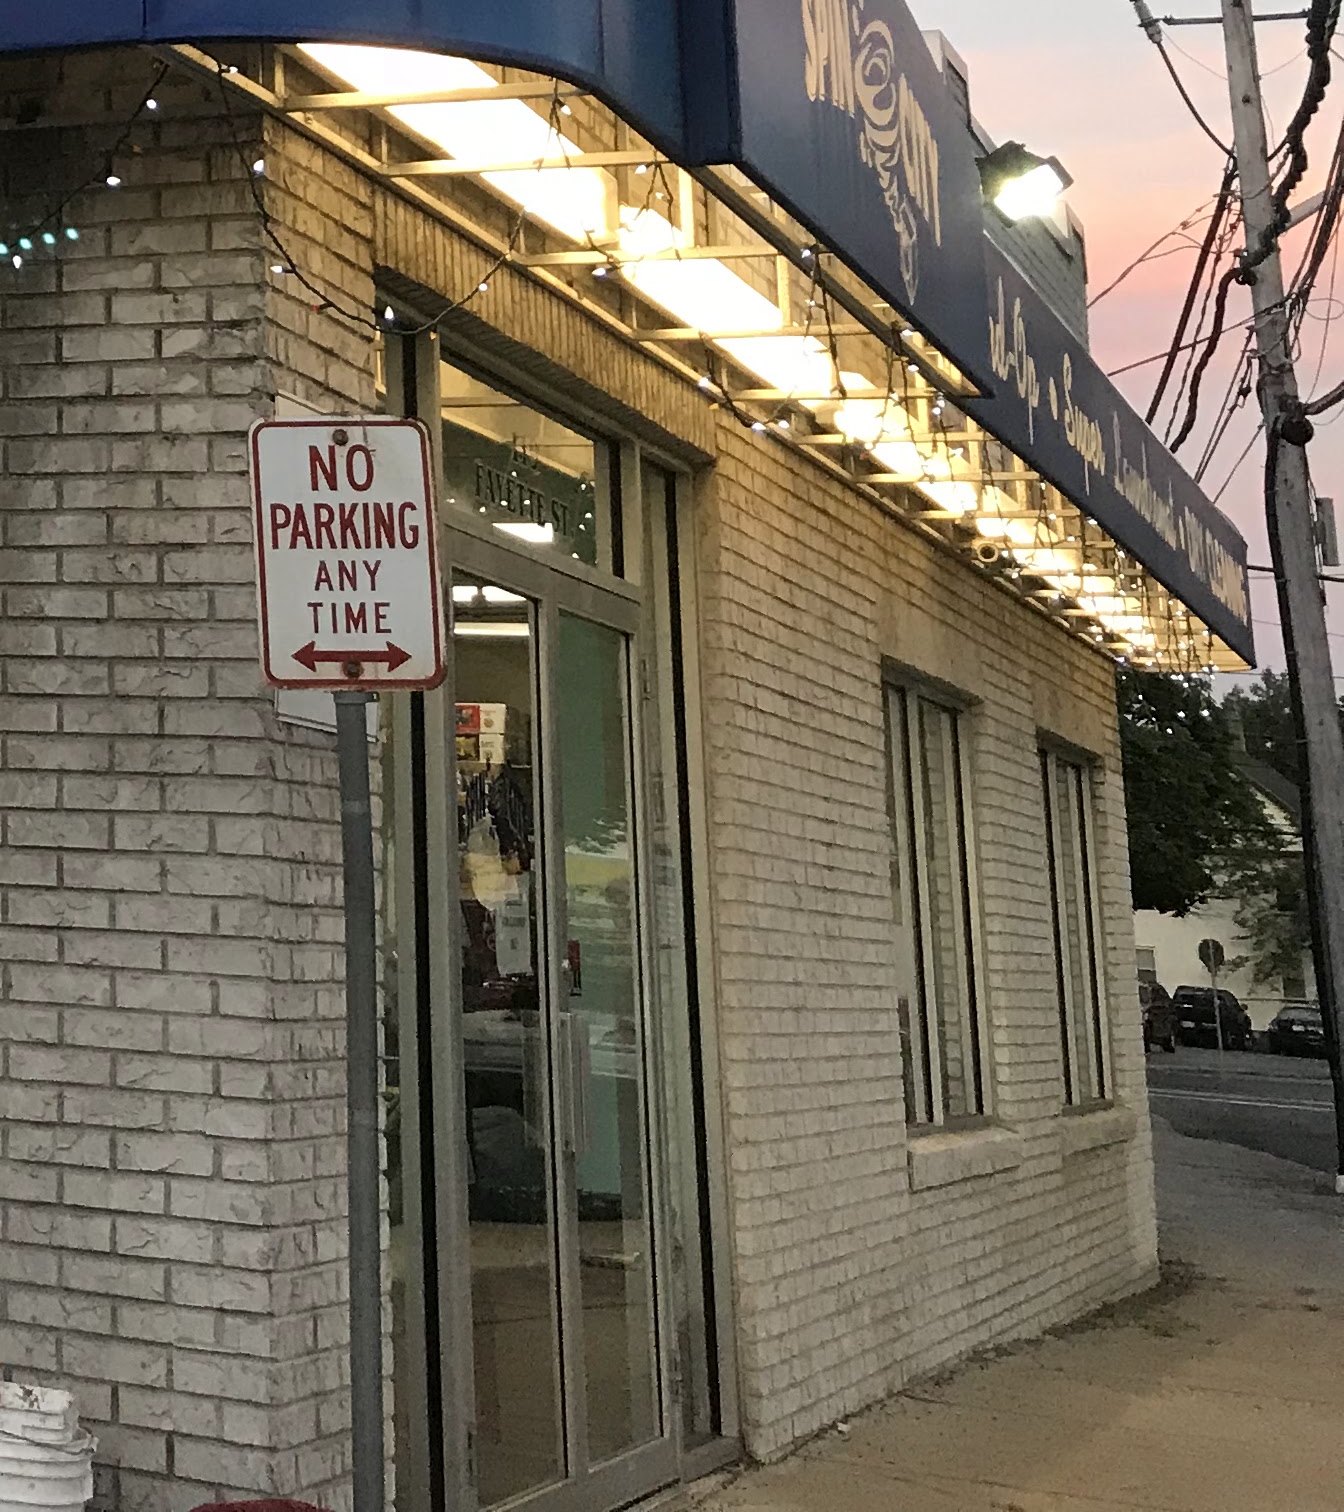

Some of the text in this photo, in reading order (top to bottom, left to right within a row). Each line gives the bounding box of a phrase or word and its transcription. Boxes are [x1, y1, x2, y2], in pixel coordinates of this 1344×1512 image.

[309, 444, 374, 491] NO
[270, 501, 419, 550] PARKING
[314, 559, 381, 591] ANY
[307, 602, 392, 634] TIME
